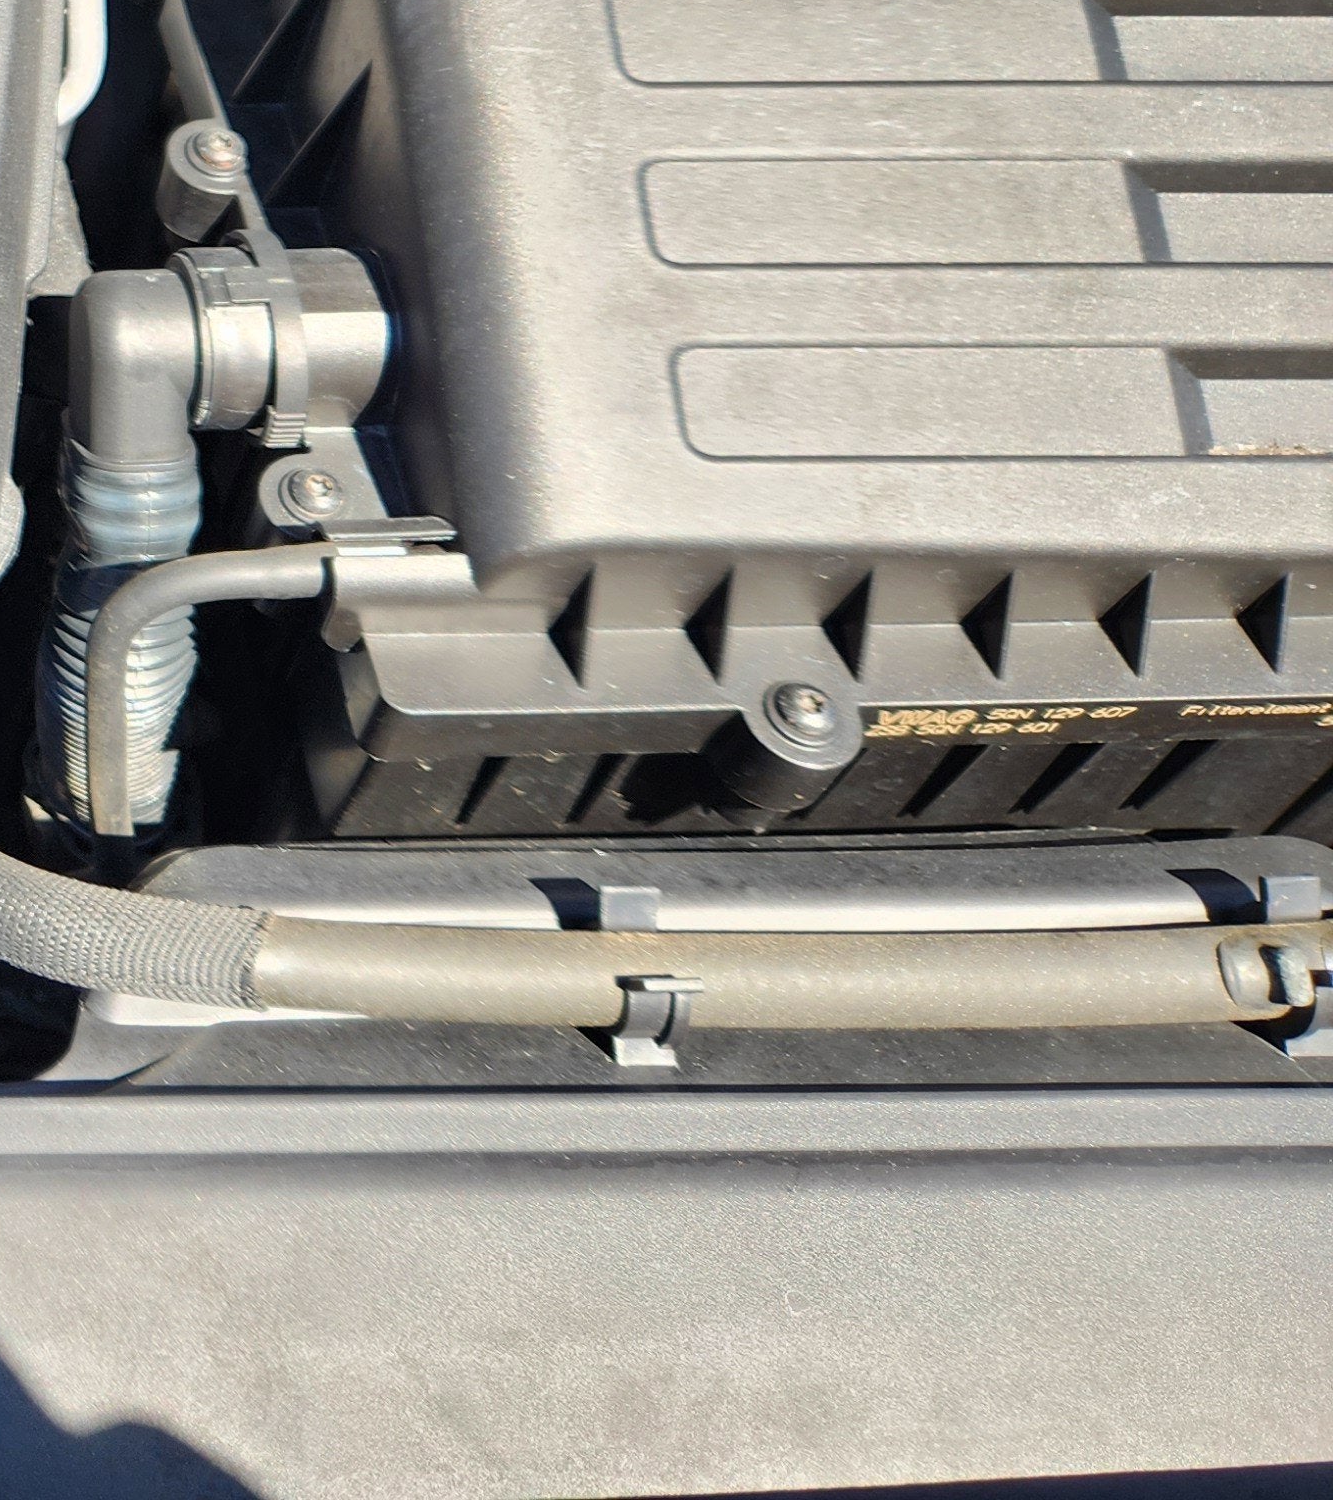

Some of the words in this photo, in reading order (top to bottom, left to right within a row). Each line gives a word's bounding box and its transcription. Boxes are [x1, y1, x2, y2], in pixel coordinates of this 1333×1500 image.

[986, 707, 1035, 721] 5QN
[1042, 706, 1085, 721] 129
[1088, 705, 1138, 720] 607
[1179, 701, 1333, 717] Filterelement
[969, 721, 1015, 735] 129
[1015, 721, 1062, 735] 601
